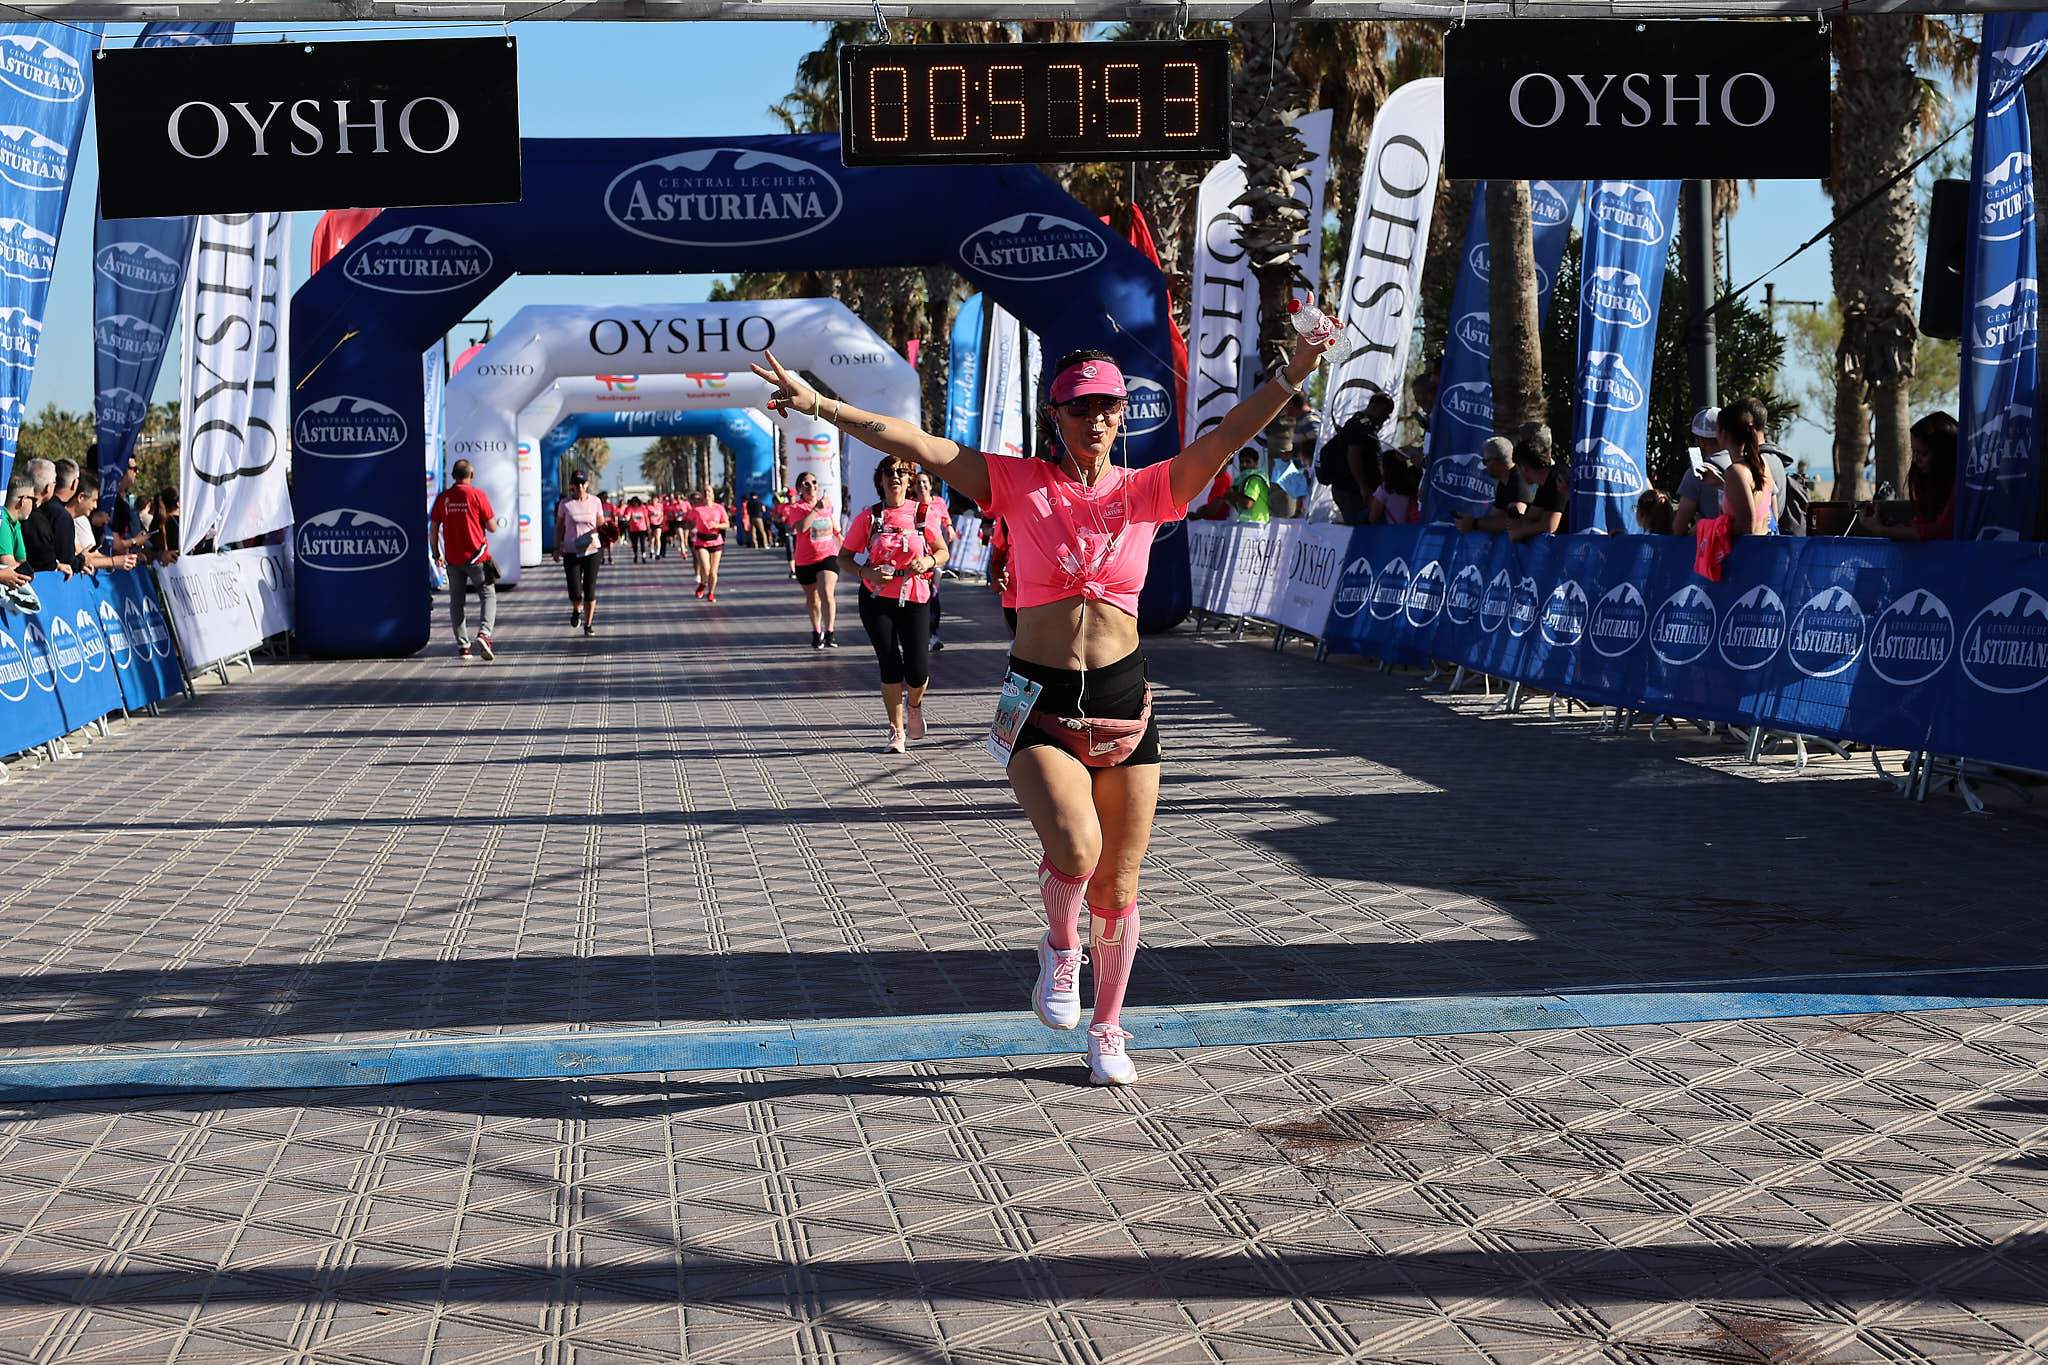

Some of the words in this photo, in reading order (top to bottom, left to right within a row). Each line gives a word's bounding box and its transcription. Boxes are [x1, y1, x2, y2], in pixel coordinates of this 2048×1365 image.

[870, 62, 1198, 141] 00:57:53
[1509, 71, 1776, 128] OYSHO
[168, 97, 460, 159] OYSHO
[658, 177, 734, 188] CENTRAL
[741, 175, 816, 187] LECHERA
[623, 179, 826, 221] ASTURIANA
[103, 252, 176, 285] ASTURIANA
[352, 252, 482, 276] ASTURIANA
[972, 241, 1099, 266] ASTURIANA
[191, 215, 256, 486] OYSH
[589, 315, 776, 355] OYSHO
[477, 364, 535, 377] OYSHO
[830, 352, 886, 366] OYSHO
[1125, 402, 1168, 420] RIANA
[299, 420, 400, 443] ASTURIANA
[454, 441, 508, 453] OYSHO
[301, 532, 401, 556] ASTURIANA
[1591, 608, 1640, 638] ASTURIANA
[1653, 612, 1710, 645] ASTURIANA
[1722, 616, 1779, 648] ASTURIANA
[1792, 615, 1858, 655] ASTURIANA
[1872, 622, 1945, 661] ASTURIANA
